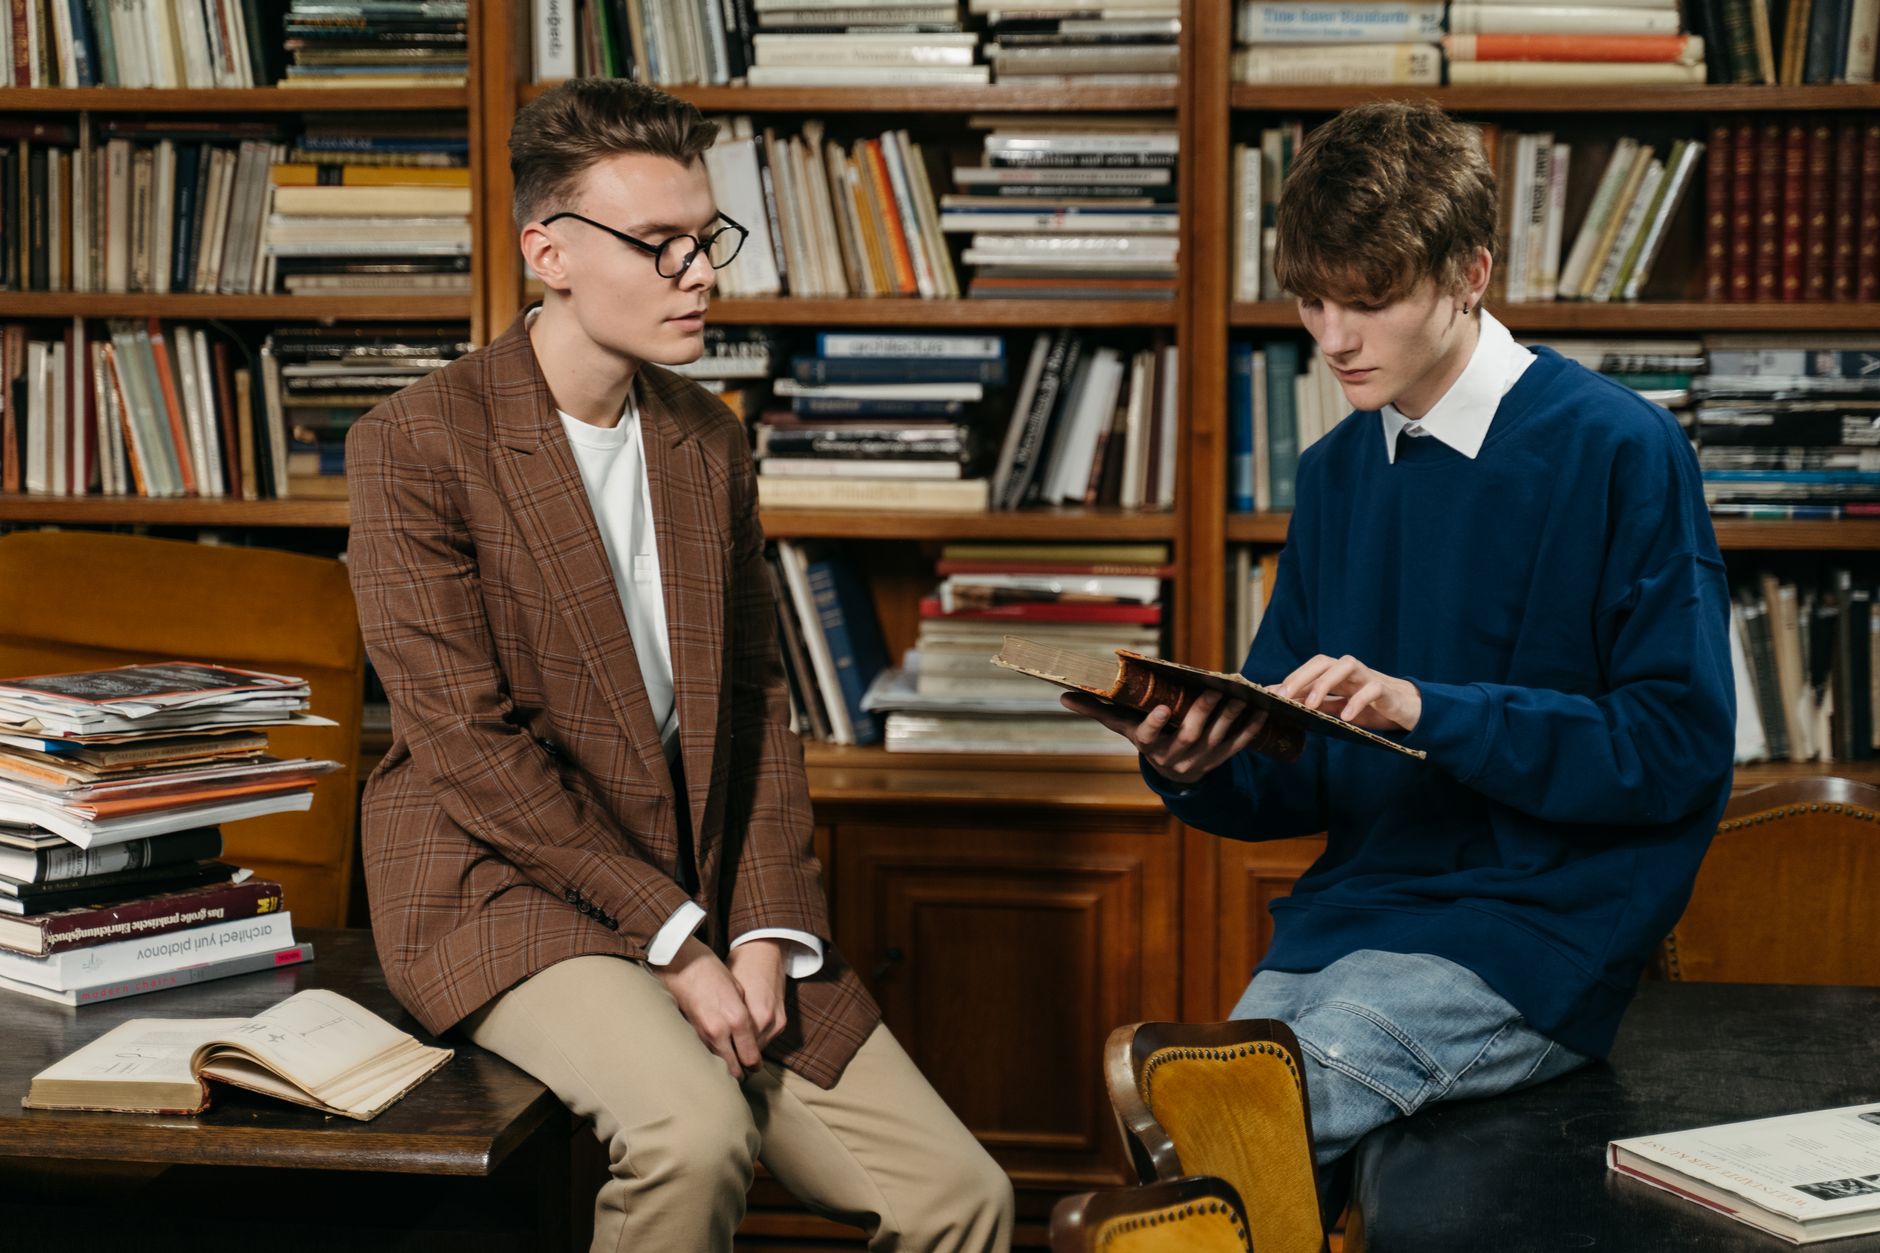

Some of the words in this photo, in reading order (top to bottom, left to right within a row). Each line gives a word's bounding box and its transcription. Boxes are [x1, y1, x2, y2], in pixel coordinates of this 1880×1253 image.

[132, 911, 180, 931] praktische
[181, 906, 207, 923] große
[207, 907, 225, 920] Das
[48, 923, 131, 945] Einrichtungsbuch
[195, 932, 216, 951] yuri
[219, 925, 272, 946] architect
[136, 938, 192, 960] platonov
[81, 983, 129, 1001] modern
[135, 977, 177, 992] chairs
